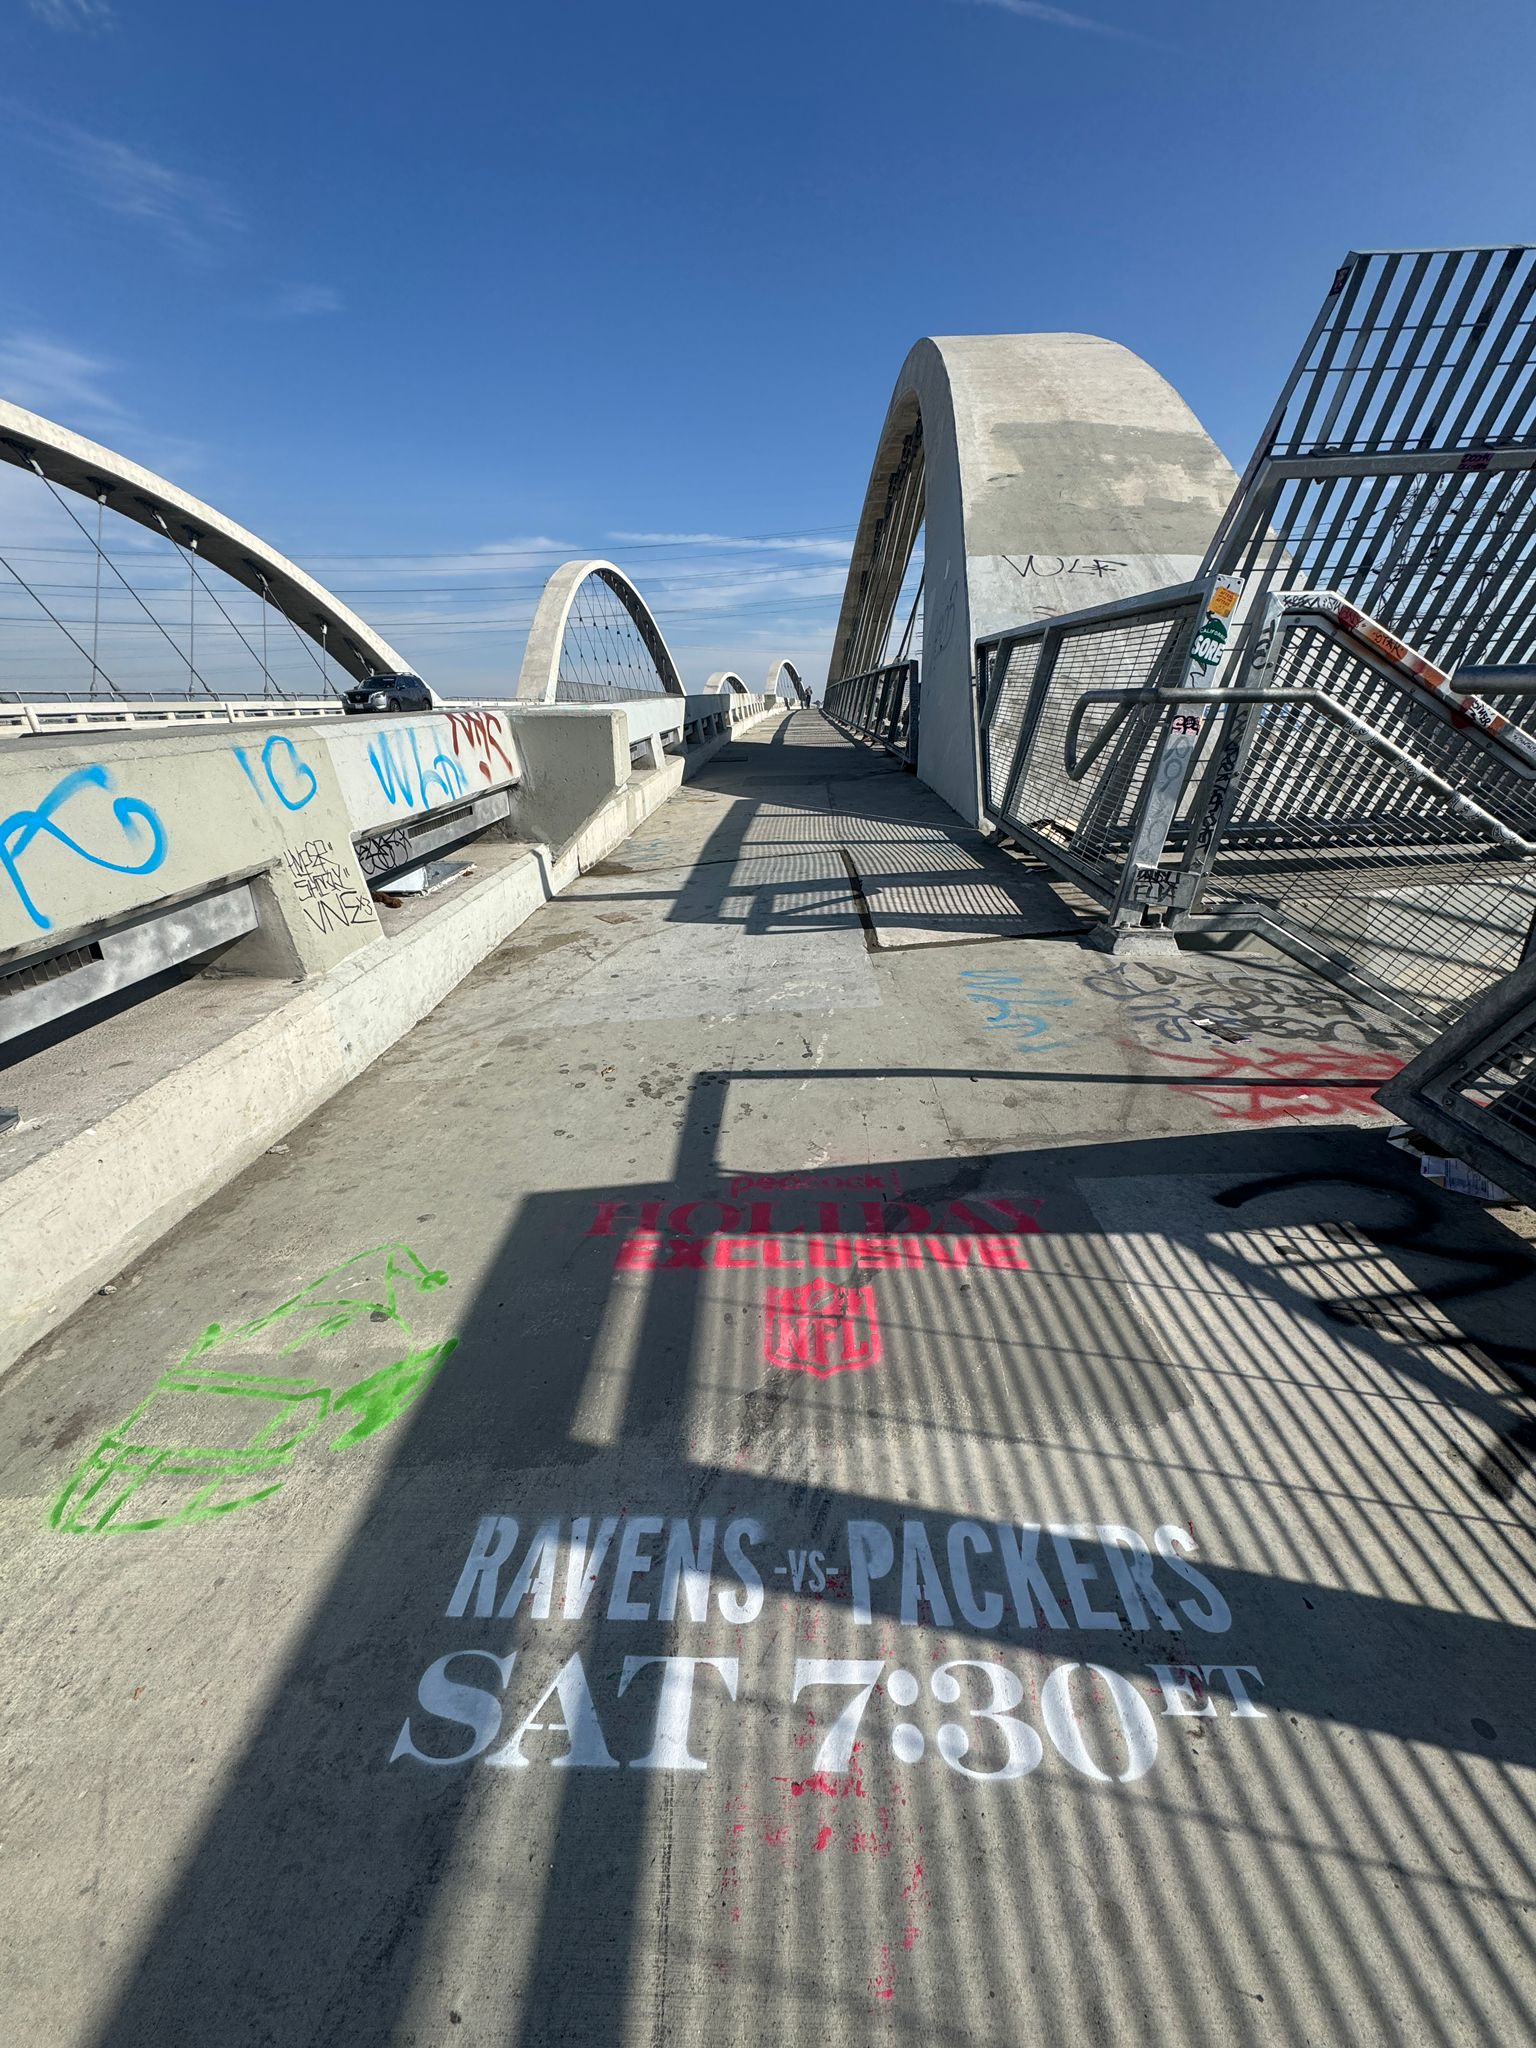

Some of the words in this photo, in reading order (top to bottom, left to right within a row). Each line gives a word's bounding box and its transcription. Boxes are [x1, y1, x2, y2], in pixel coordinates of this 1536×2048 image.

[1191, 634, 1226, 663] SORE
[583, 1199, 1046, 1236] HOLIDAY
[613, 1236, 1031, 1270] EXCLUSIVE
[777, 1316, 870, 1366] NFL
[445, 1515, 766, 1626] RAVENS
[847, 1519, 1234, 1634] PACKERS
[389, 1649, 740, 1771] SAT
[792, 1657, 1161, 1783] 7:30
[1143, 1663, 1268, 1719] ET
